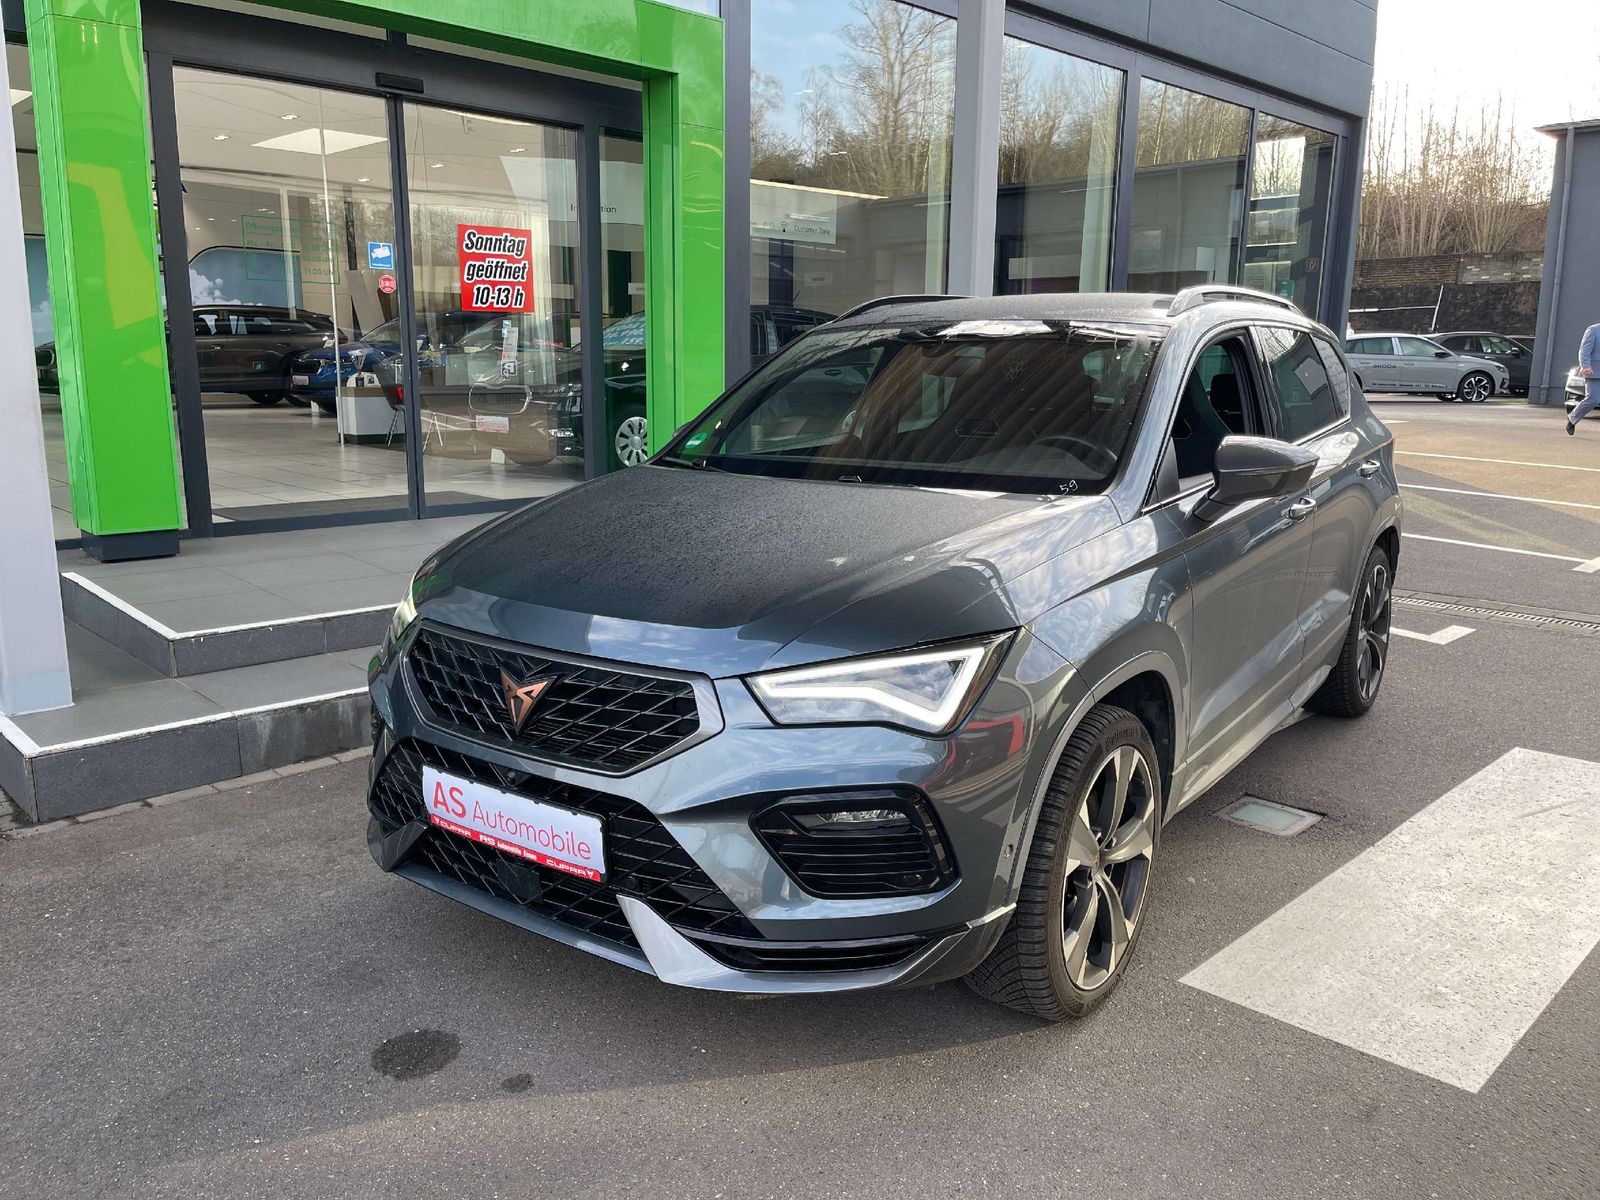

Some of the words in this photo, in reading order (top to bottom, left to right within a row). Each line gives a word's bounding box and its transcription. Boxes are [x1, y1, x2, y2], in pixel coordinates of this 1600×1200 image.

[464, 230, 526, 257] Sonntag
[465, 260, 527, 281] geöffnet
[474, 286, 511, 306] 10-13
[514, 287, 524, 307] h
[1059, 479, 1079, 496] 59
[433, 780, 467, 819] AS
[472, 800, 591, 860] Automobile
[546, 858, 587, 877] CUPRA
